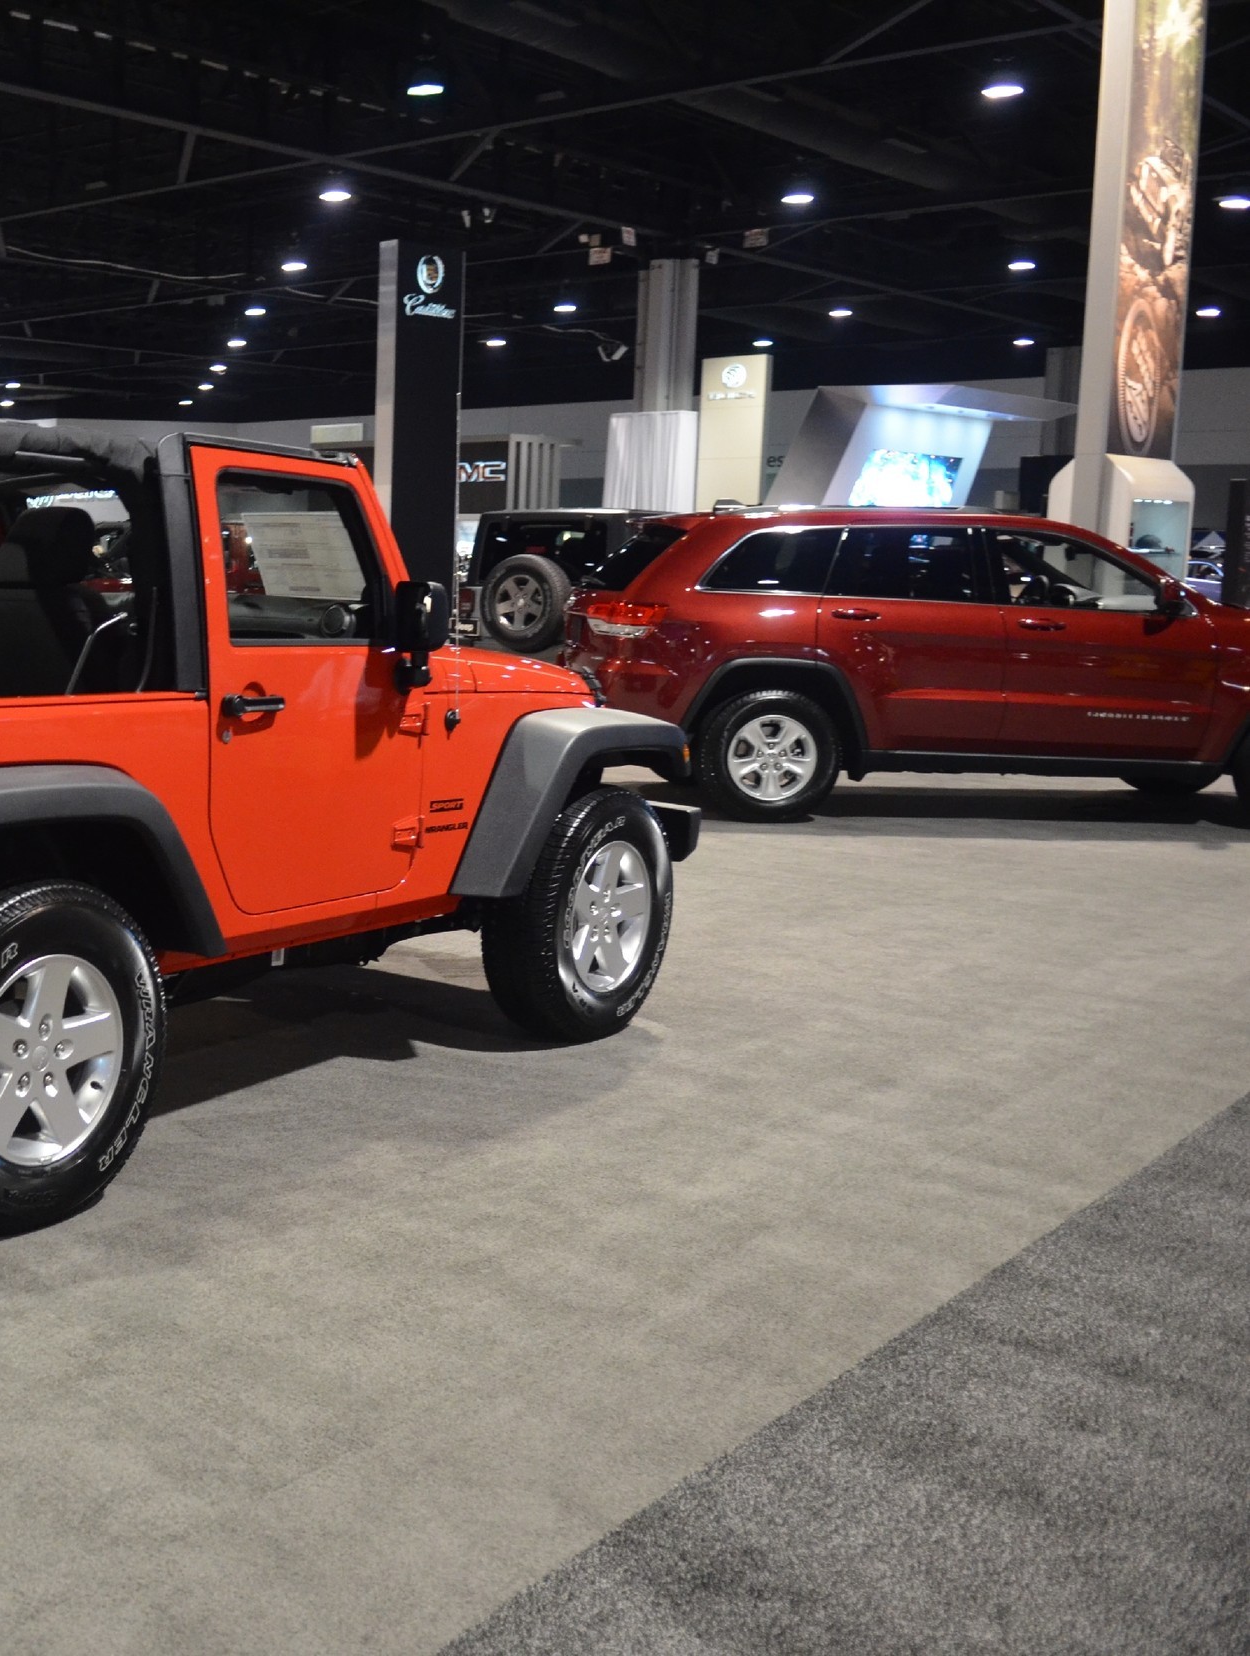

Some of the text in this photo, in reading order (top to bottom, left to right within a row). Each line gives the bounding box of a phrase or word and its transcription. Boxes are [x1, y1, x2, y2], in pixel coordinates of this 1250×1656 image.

[456, 461, 507, 482] MC
[430, 799, 464, 812] SPORT
[425, 821, 469, 833] WRANGLER
[99, 969, 156, 1172] WRANGLER
